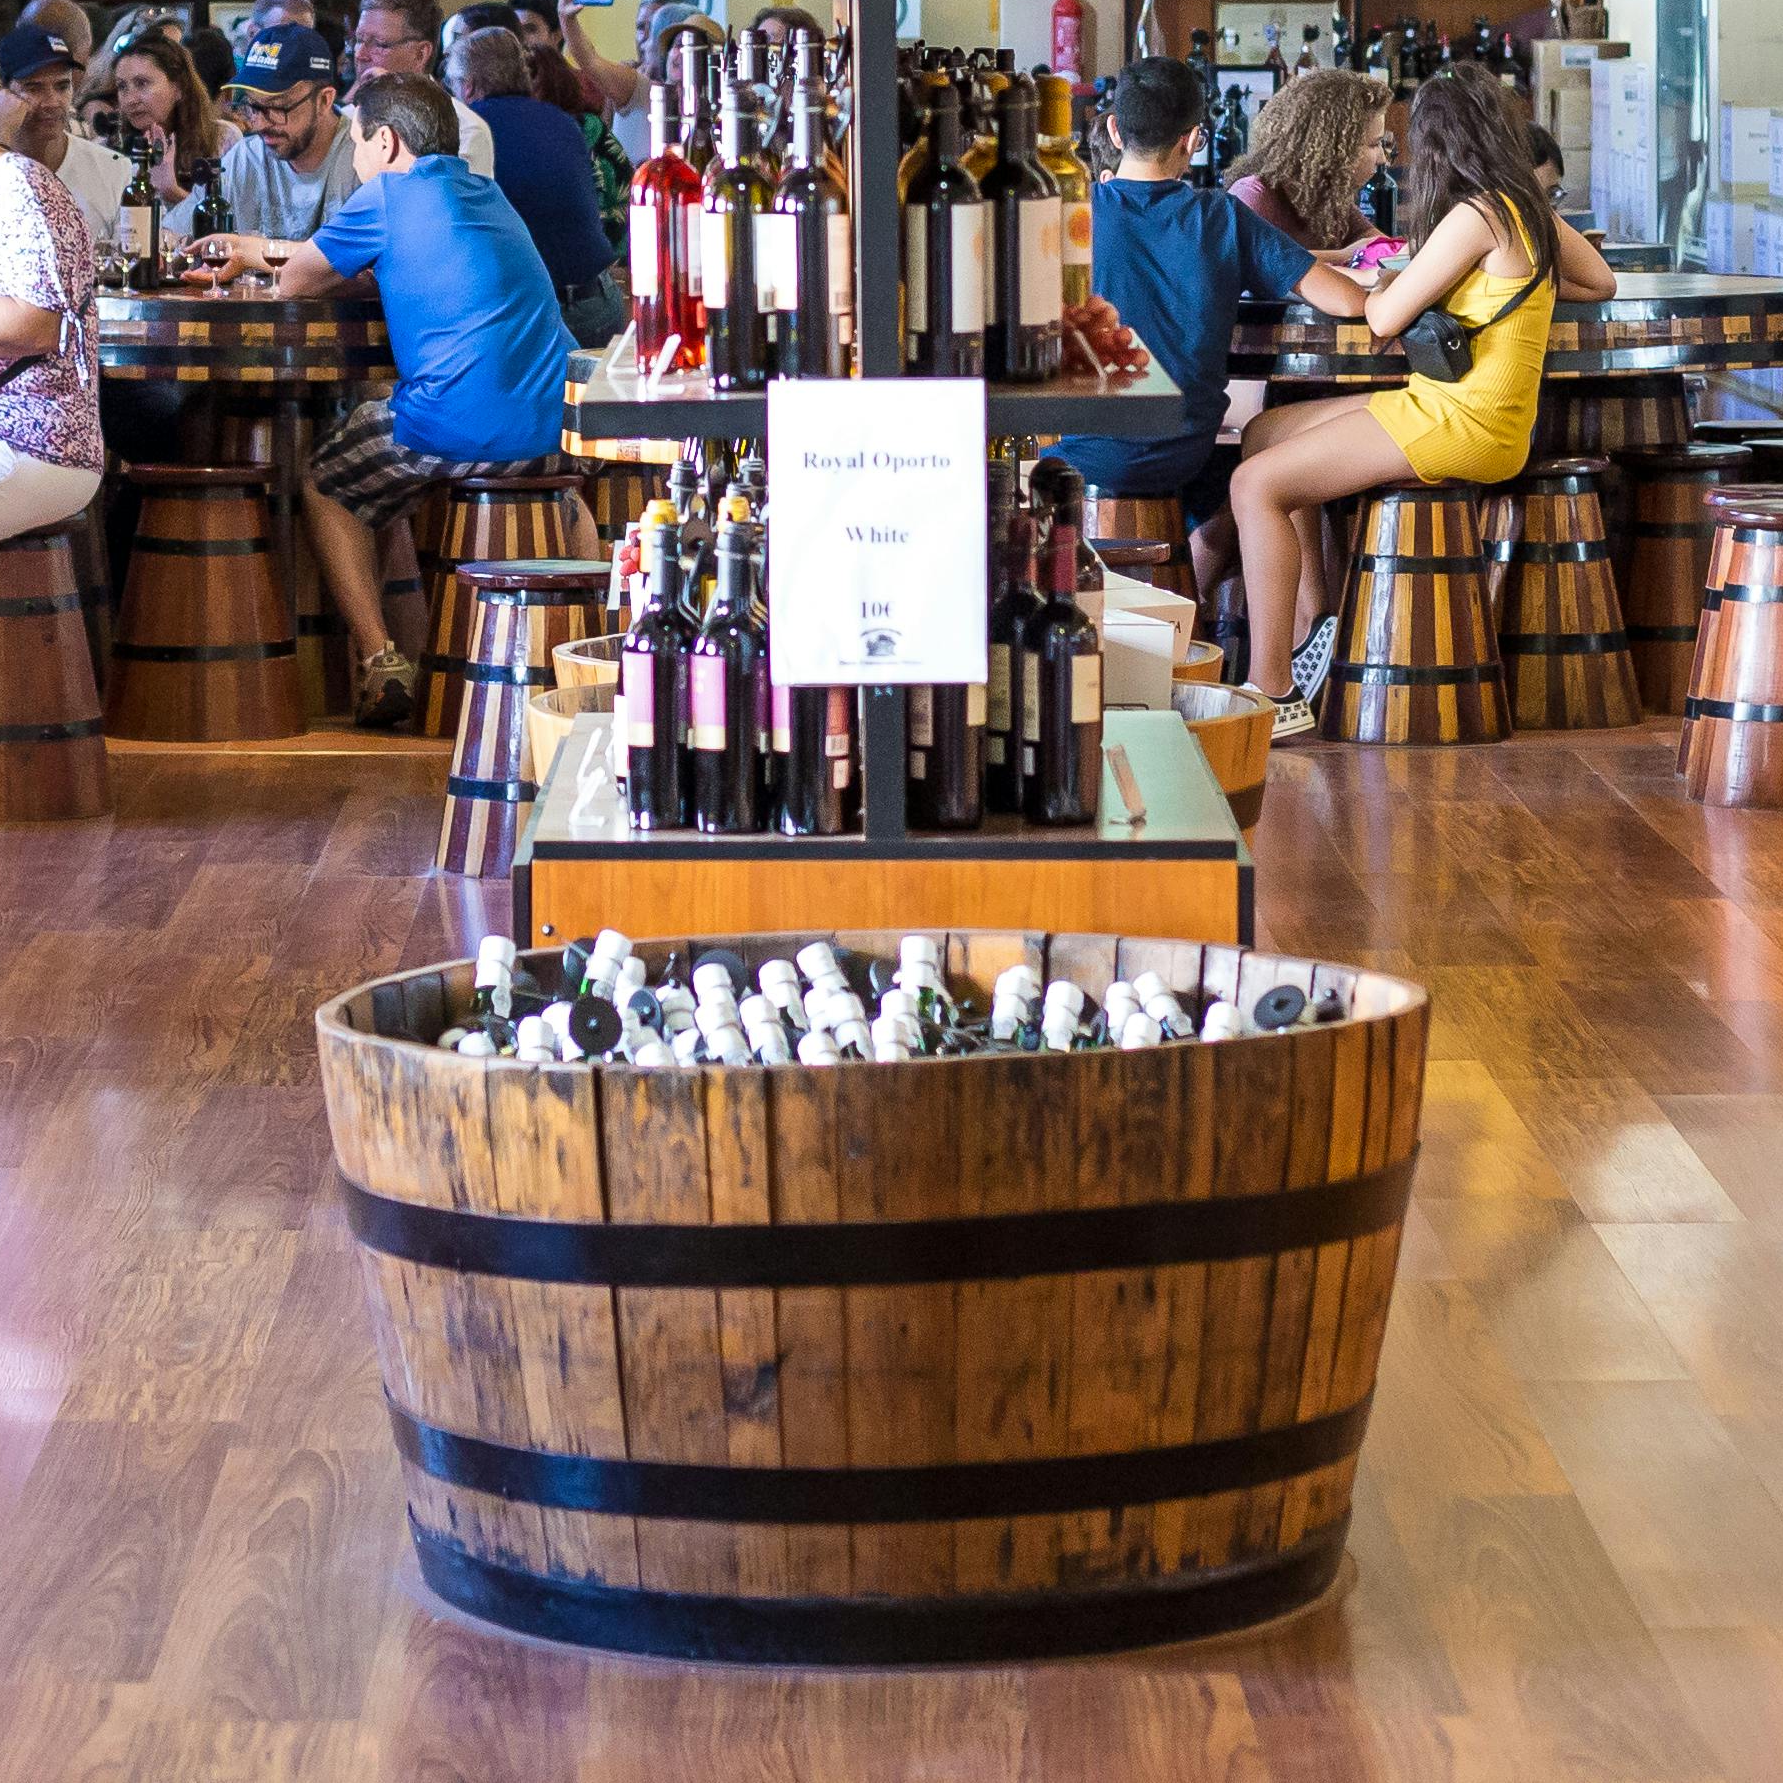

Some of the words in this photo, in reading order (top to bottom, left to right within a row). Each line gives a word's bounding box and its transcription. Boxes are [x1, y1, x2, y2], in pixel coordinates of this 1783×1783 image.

[804, 452, 864, 473] Royal
[873, 452, 950, 472] Oporto
[846, 526, 909, 543] White
[861, 602, 893, 618] 10€
